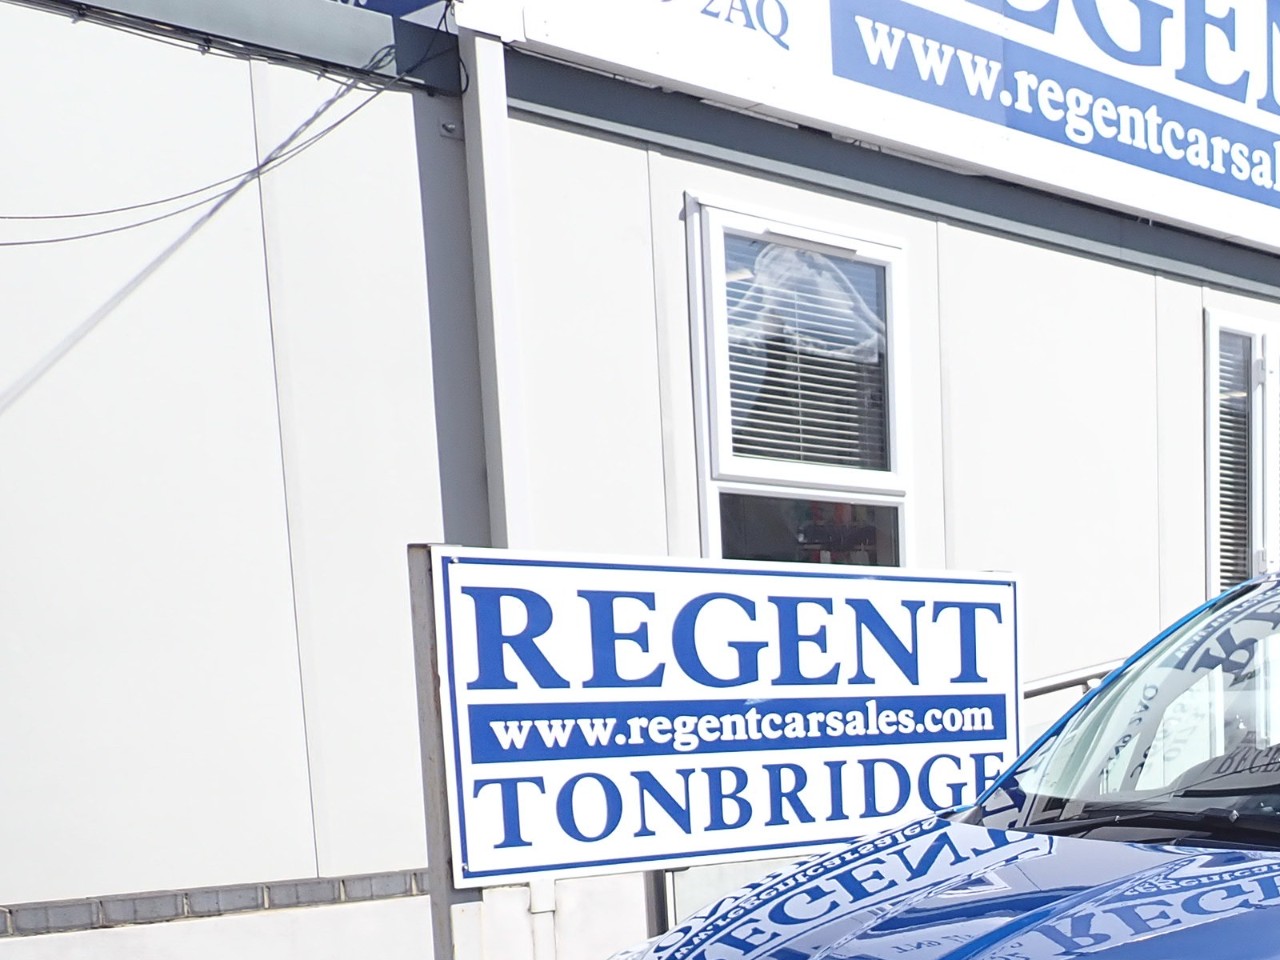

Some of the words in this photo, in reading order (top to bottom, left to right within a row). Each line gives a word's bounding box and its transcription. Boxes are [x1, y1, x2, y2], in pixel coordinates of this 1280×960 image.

[460, 585, 1003, 691] REGENT
[489, 700, 994, 751] www.regentcarsales.com
[472, 752, 1004, 849] TONBRIDGE
